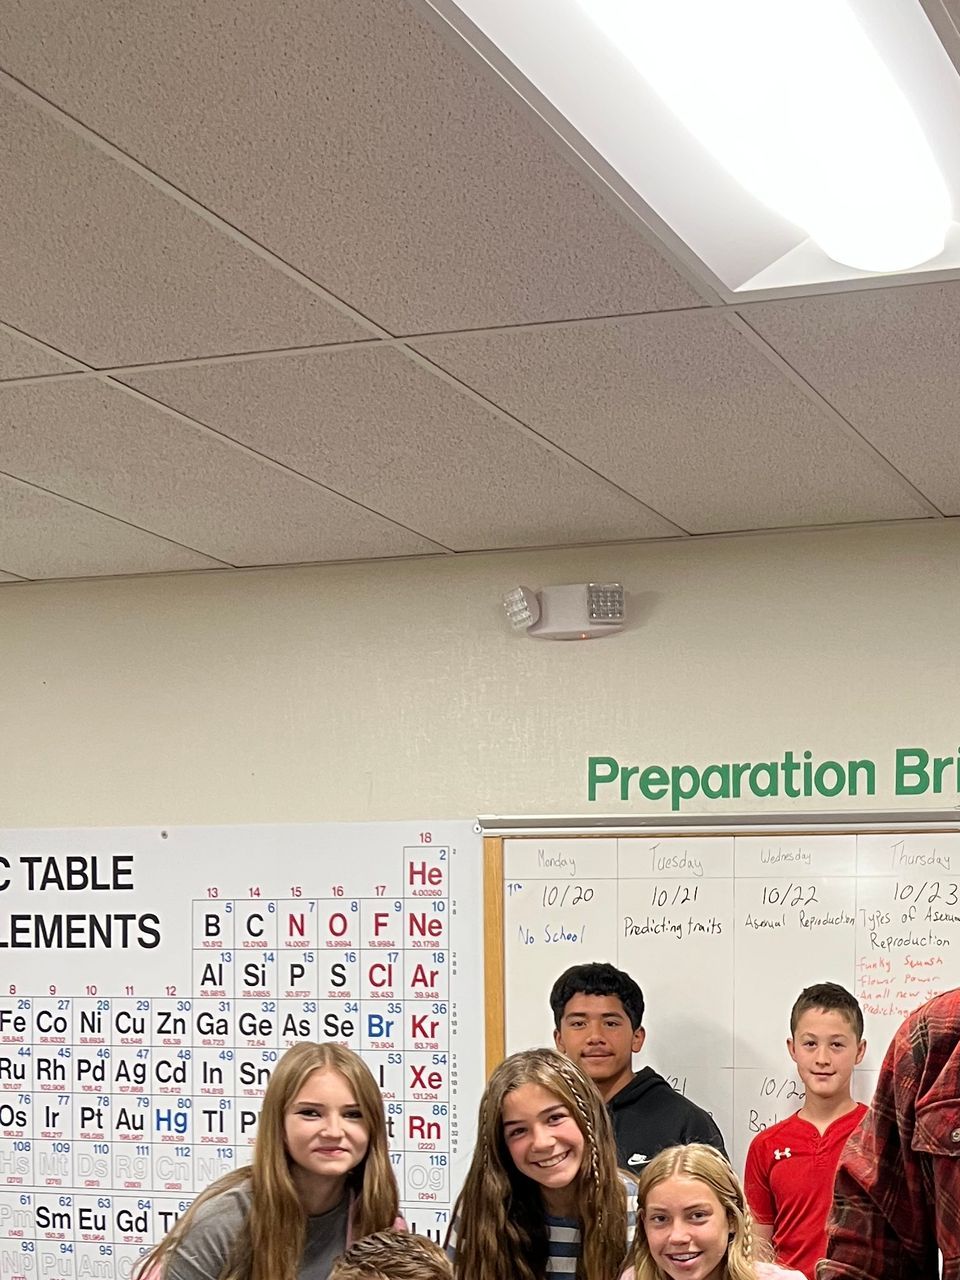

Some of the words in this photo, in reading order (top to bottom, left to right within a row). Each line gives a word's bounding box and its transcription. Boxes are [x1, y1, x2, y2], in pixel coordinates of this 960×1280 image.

[587, 751, 875, 811] Preparation
[420, 833, 431, 842] 18
[440, 850, 446, 860] 2
[649, 843, 704, 876] Tuesday
[761, 848, 812, 864] Wednesday
[890, 840, 951, 870] Thursday
[538, 849, 576, 876] Monday
[20, 856, 134, 890] TABLE
[410, 862, 442, 885] He
[207, 888, 218, 897] 13
[250, 887, 260, 897] 14
[291, 887, 301, 897] 15
[332, 886, 343, 896] 16
[376, 886, 386, 896] 17
[542, 885, 594, 907] 10/20
[651, 885, 698, 906] 10/21
[762, 883, 819, 906] 10/22
[894, 881, 958, 906] 10/23
[225, 903, 232, 912] 5
[268, 903, 275, 912] 6
[309, 903, 315, 912] 7
[351, 902, 358, 911] 8
[394, 902, 401, 911] 9
[432, 902, 445, 911] 10
[902, 905, 917, 923] of
[329, 913, 347, 936] O
[375, 913, 389, 936] F
[410, 913, 442, 936] Ne
[799, 909, 855, 930] Reproduction
[206, 914, 220, 936] B
[247, 914, 264, 937] C
[289, 914, 304, 936] N
[624, 916, 683, 939] Predicting
[688, 917, 722, 935] traits
[519, 925, 535, 945] No
[544, 924, 586, 944] School
[870, 929, 950, 952] Reproduction
[220, 953, 231, 962] 13
[263, 953, 274, 962] 14
[304, 953, 314, 962] 15
[345, 953, 356, 962] 16
[388, 953, 398, 962] 17
[432, 953, 444, 962] 18
[201, 964, 222, 985] Al
[244, 964, 265, 986] Si
[291, 964, 305, 986] P
[331, 964, 346, 987] S
[369, 964, 392, 987] Cl
[411, 964, 438, 987] Ar
[10, 985, 16, 994] 8
[50, 985, 56, 995] 9
[87, 986, 97, 995] 10
[125, 986, 133, 995] 11
[166, 986, 176, 995] 12
[18, 1001, 30, 1009] 26
[58, 1001, 69, 1010] 27
[97, 1001, 109, 1010] 28
[137, 1001, 149, 1010] 29
[177, 1002, 191, 1011] 30
[219, 1002, 230, 1011] 31
[262, 1002, 275, 1012] 32
[303, 1003, 316, 1012] 33
[344, 1003, 358, 1012] 34
[387, 1004, 401, 1013] 35
[432, 1004, 447, 1014] 36
[0, 1011, 25, 1032] Fe
[37, 1011, 67, 1033] Co
[81, 1012, 101, 1033] Ni
[116, 1012, 144, 1034] Cu
[157, 1012, 186, 1034] Zn
[197, 1012, 228, 1035] Ga
[239, 1013, 272, 1036] Ge
[283, 1014, 310, 1036] As
[324, 1014, 354, 1037] Se
[368, 1014, 394, 1037] Br
[412, 1015, 439, 1038] Kr
[18, 1048, 31, 1056] 44
[58, 1048, 71, 1057] 45
[97, 1049, 110, 1058] 46
[137, 1049, 148, 1058] 47
[178, 1050, 190, 1059] 48
[219, 1051, 233, 1060] 49
[262, 1052, 277, 1061] 50
[387, 1054, 401, 1063] 53
[432, 1055, 447, 1065] 54
[0, 1058, 25, 1079] Ru
[37, 1059, 65, 1080] Rh
[78, 1059, 104, 1081] Pd
[116, 1060, 146, 1084] Ag
[156, 1060, 186, 1083] Cd
[203, 1062, 222, 1084] In
[240, 1062, 270, 1085] Sn
[410, 1065, 442, 1089] Xe
[18, 1095, 31, 1104] 76
[58, 1096, 69, 1105] 77
[97, 1097, 109, 1106] 78
[137, 1097, 149, 1107] 79
[178, 1099, 191, 1108] 80
[220, 1100, 231, 1109] 81
[388, 1104, 402, 1114] 85
[432, 1105, 447, 1115] 86
[0, 1105, 26, 1127] Os
[46, 1106, 59, 1127] Ir
[81, 1107, 103, 1128] Pt
[116, 1108, 143, 1130] Au
[156, 1109, 187, 1133] Hg
[203, 1111, 223, 1132] Tl
[409, 1116, 441, 1140] Rn
[13, 1142, 30, 1151] 108
[52, 1143, 70, 1152] 109
[94, 1144, 109, 1154] 110
[136, 1146, 149, 1155] 111
[175, 1147, 190, 1156] 112
[217, 1149, 232, 1158] 113
[429, 1156, 446, 1165] 118
[20, 1195, 30, 1204] 61
[59, 1197, 71, 1206] 62
[98, 1198, 110, 1208] 63
[138, 1200, 151, 1209] 64
[36, 1206, 71, 1228] Sm
[80, 1209, 105, 1230] Eu
[117, 1210, 147, 1232] Gd
[435, 1212, 446, 1222] 71
[22, 1242, 34, 1251] 93
[60, 1244, 72, 1253] 94
[99, 1246, 112, 1255] 95
